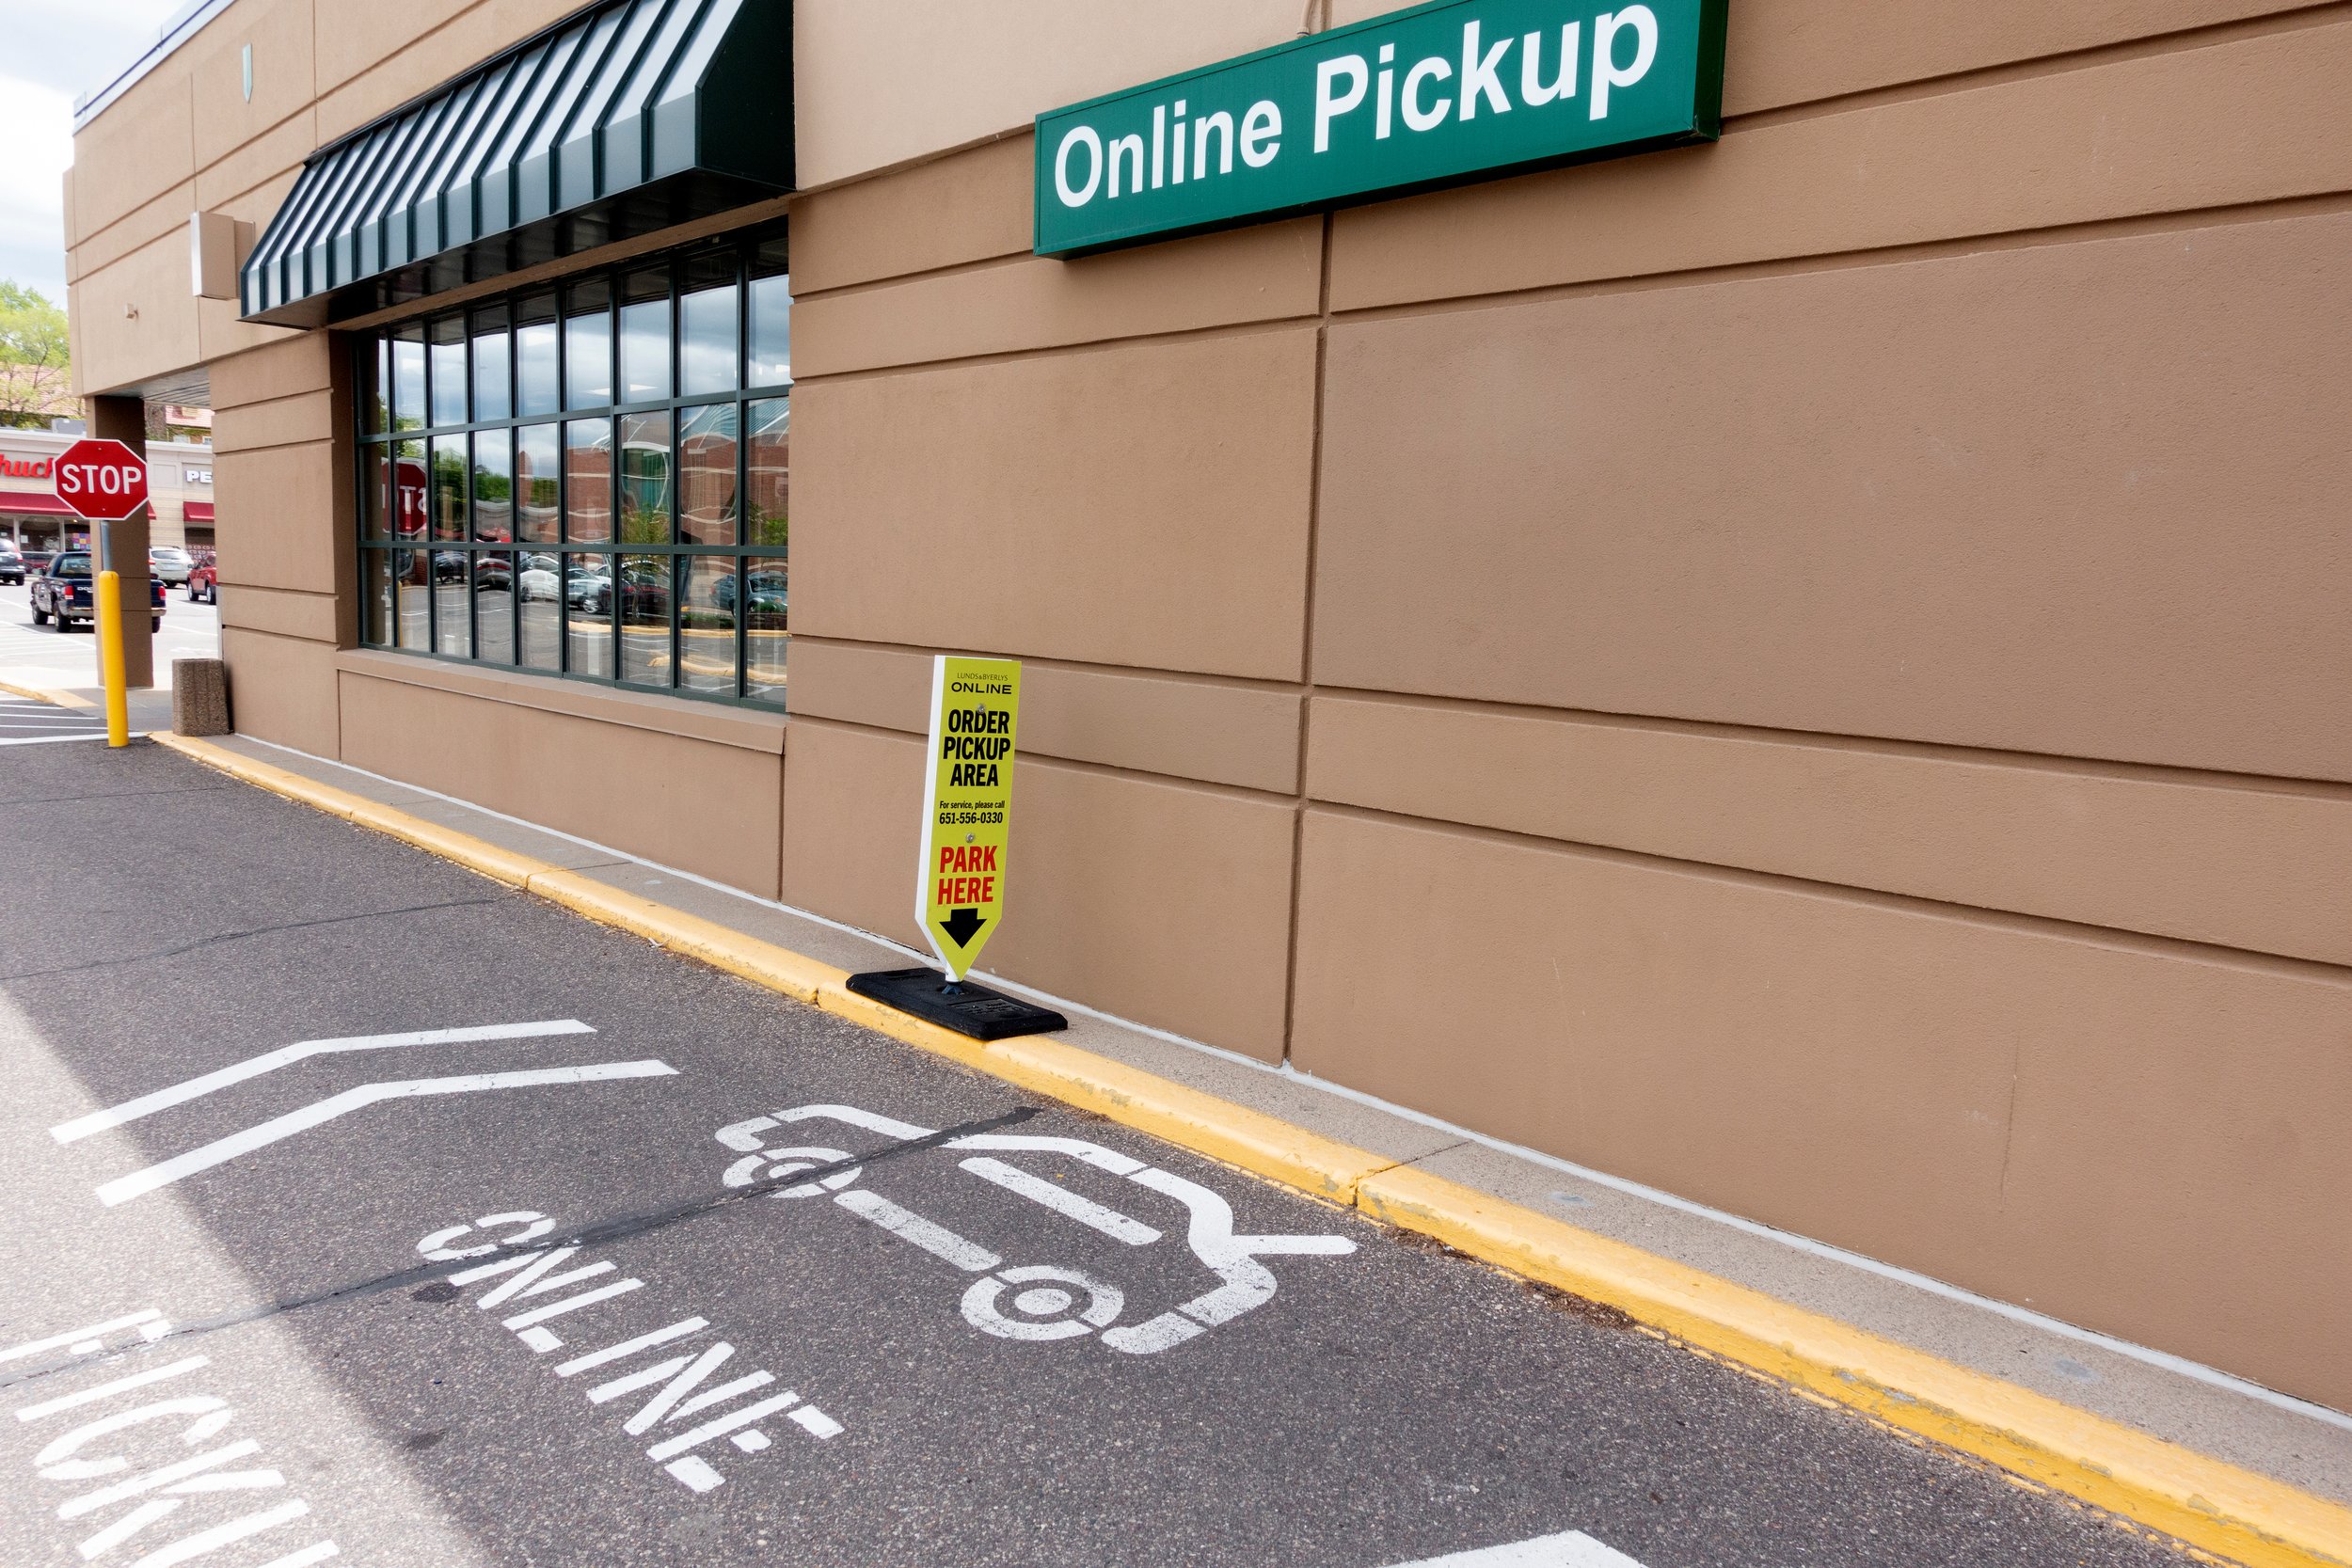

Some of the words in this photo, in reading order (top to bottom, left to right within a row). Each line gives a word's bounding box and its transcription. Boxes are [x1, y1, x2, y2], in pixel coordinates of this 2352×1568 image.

[1055, 99, 1283, 208] Online
[1313, 4, 1659, 153] Pickup
[61, 464, 142, 495] STOP
[951, 682, 1012, 694] ONLINE
[948, 709, 1010, 734] ORDER
[943, 736, 1011, 760] PICKUP
[949, 763, 998, 786] AREA
[939, 800, 949, 809] For
[950, 800, 973, 810] service,
[975, 800, 993, 810] please
[994, 800, 1005, 809] call
[939, 812, 1004, 824] 651-556-0330
[939, 846, 997, 873] PARK
[937, 876, 994, 905] HERE
[416, 1211, 845, 1493] ONLINE
